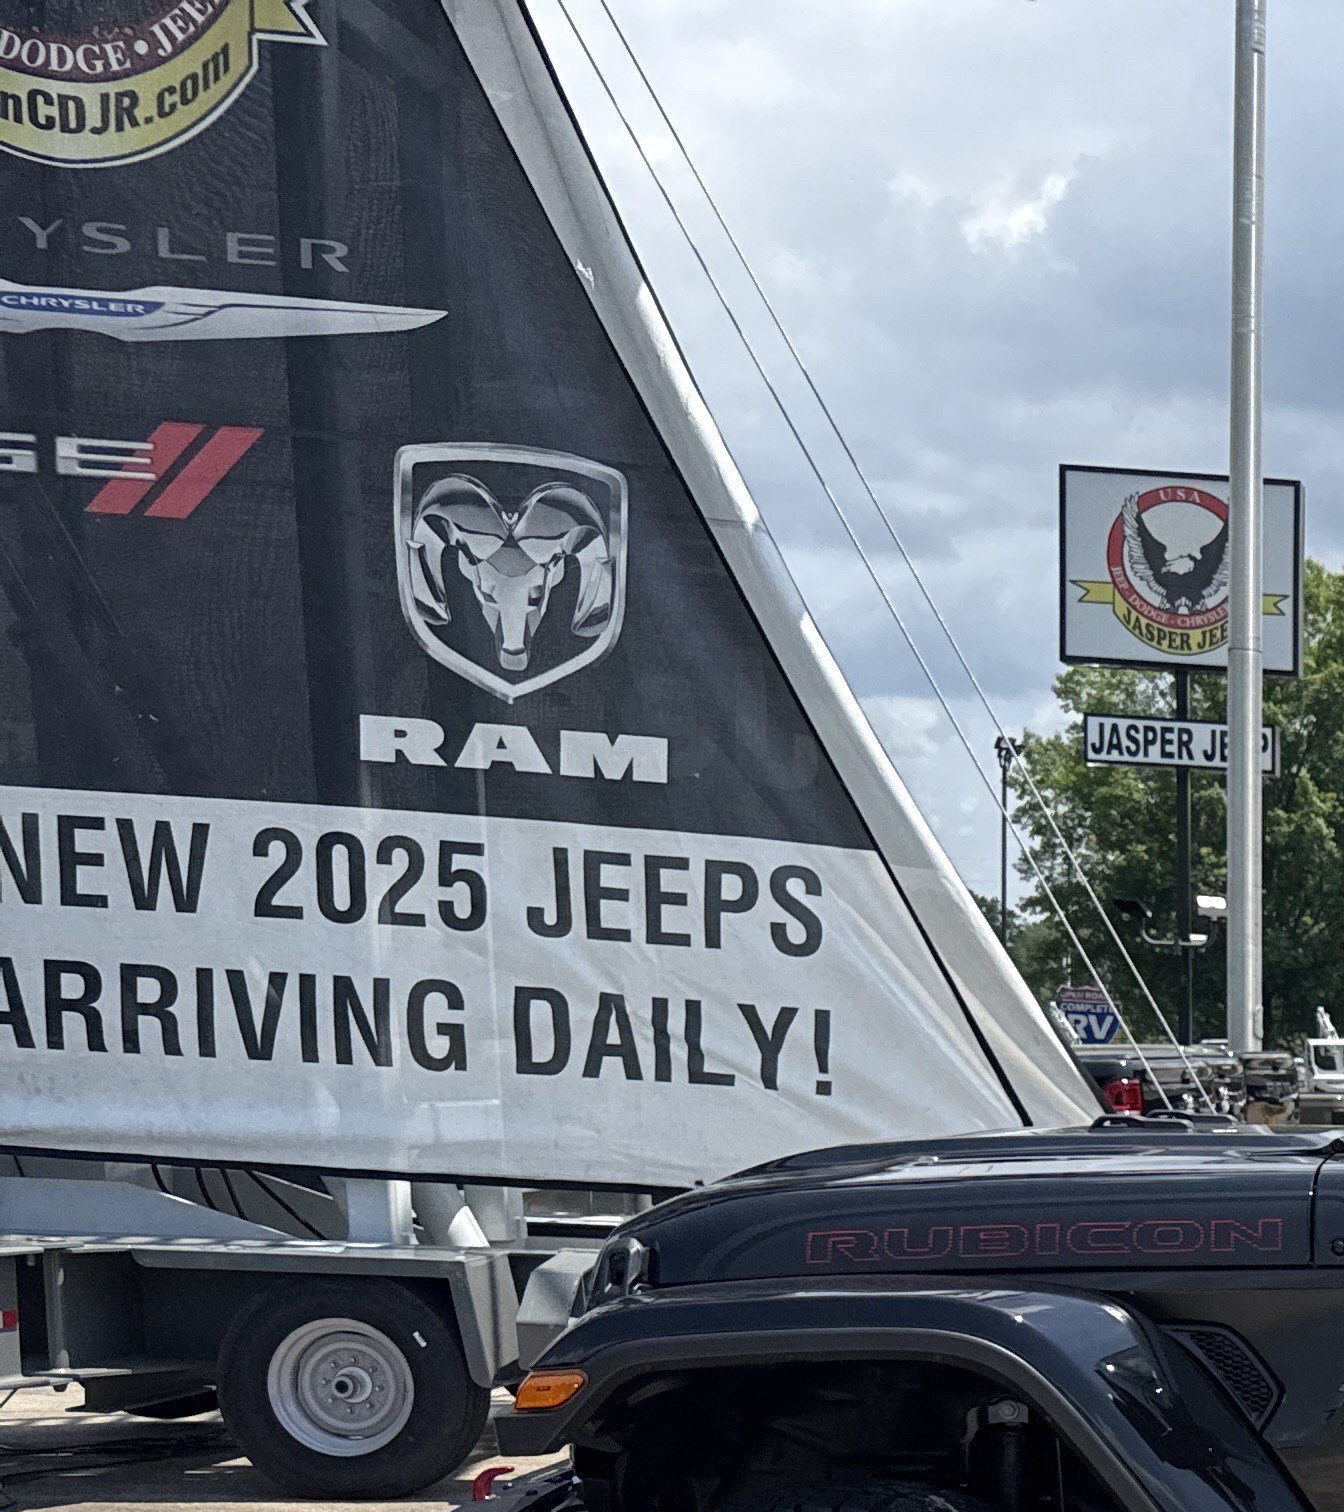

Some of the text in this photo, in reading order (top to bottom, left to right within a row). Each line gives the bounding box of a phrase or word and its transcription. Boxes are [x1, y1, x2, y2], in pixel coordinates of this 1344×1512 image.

[0, 0, 224, 74] DODGE JEE
[18, 216, 350, 273] YSLER
[0, 293, 146, 314] CHRYSLER
[1158, 488, 1200, 503] USA
[1122, 606, 1229, 651] JASPER JEE
[1128, 594, 1171, 624] DODGE
[1176, 603, 1229, 627] CHRYSLE
[359, 713, 669, 785] RAM
[1090, 722, 1195, 761] JASPER
[0, 811, 823, 958] NEW 2025 JEEPS
[0, 956, 832, 1096] ARRIVING DAILY!
[1067, 1013, 1115, 1040] RV
[805, 1217, 1284, 1265] RUBICON
